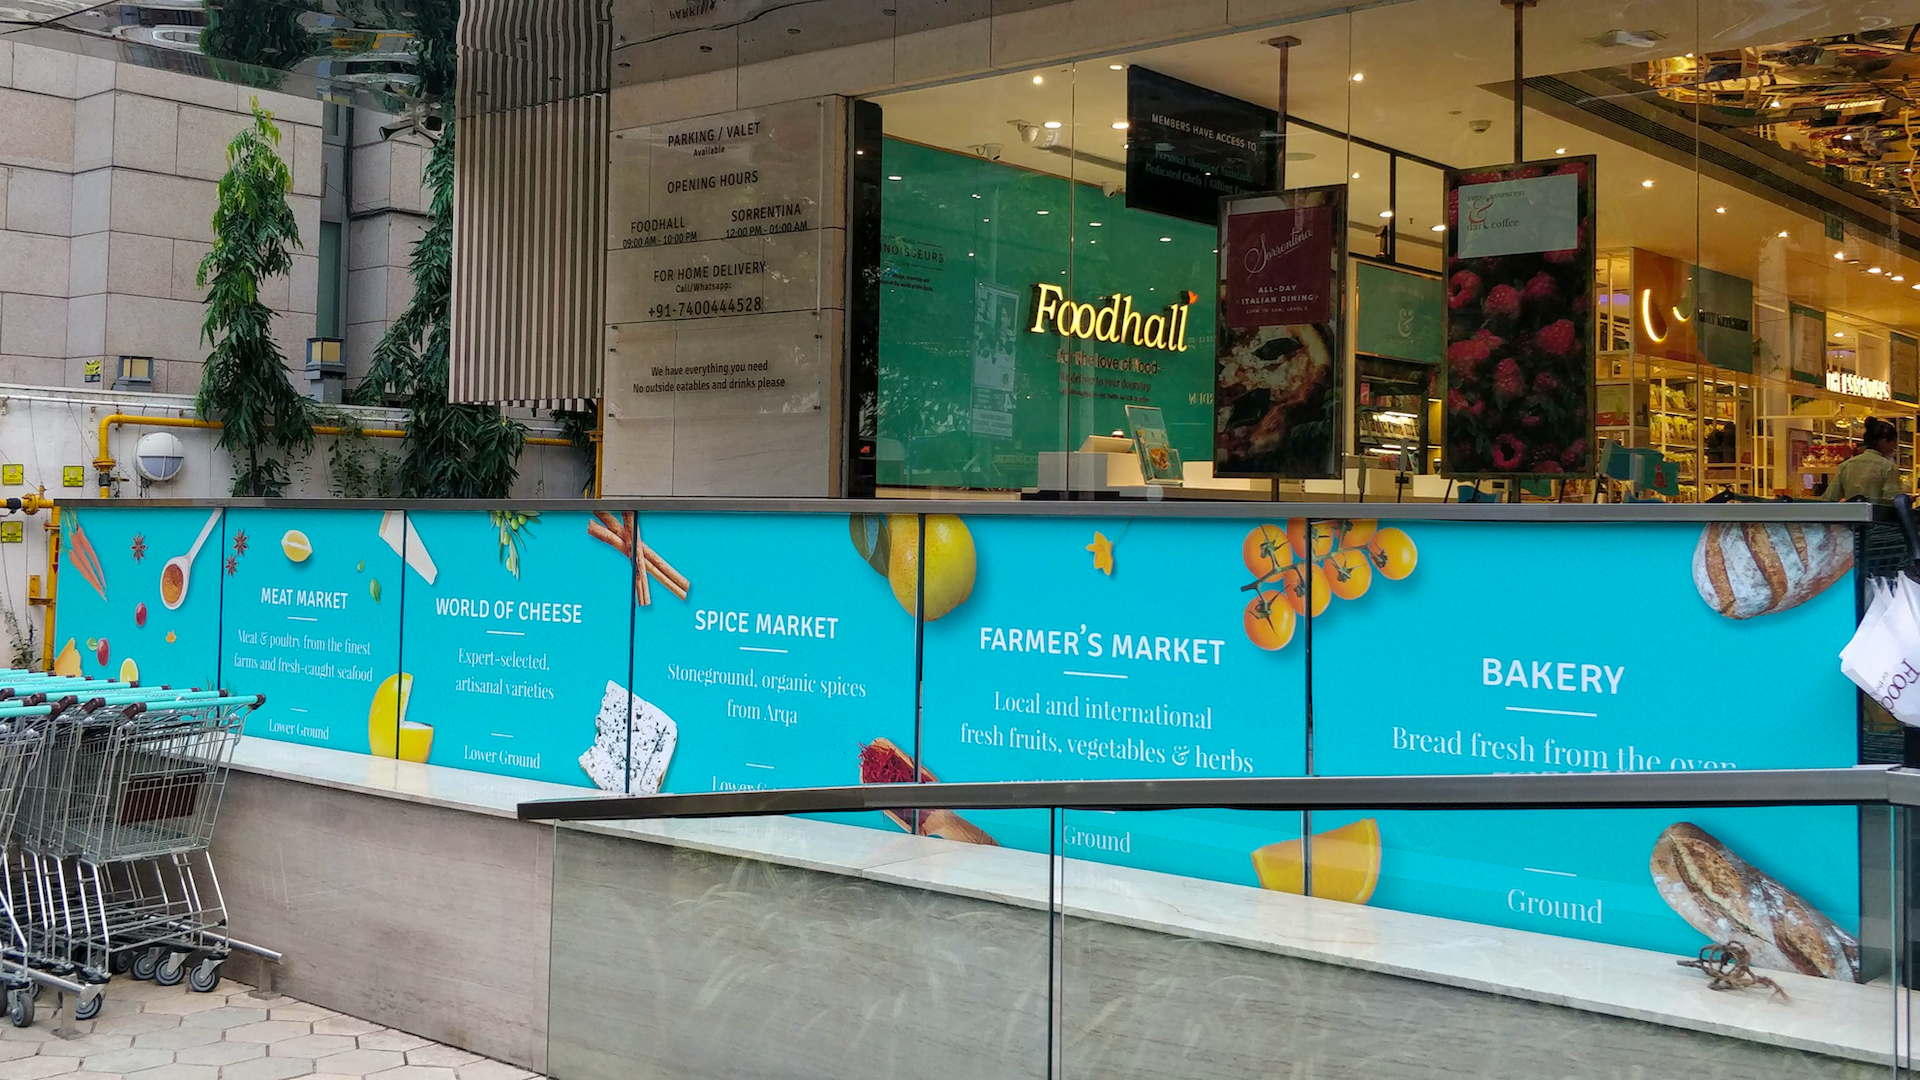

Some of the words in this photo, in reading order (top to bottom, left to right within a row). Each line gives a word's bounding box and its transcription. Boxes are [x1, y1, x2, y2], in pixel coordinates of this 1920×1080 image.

[667, 127, 715, 147] PARKING
[726, 121, 761, 138] VALET
[1152, 113, 1191, 133] MEMBERS
[1193, 125, 1214, 139] HAVE
[1216, 132, 1245, 149] ACCESS
[1247, 141, 1258, 152] TO
[693, 145, 725, 157] Available
[1155, 150, 1186, 166] Personal
[667, 176, 716, 194] OPENING
[719, 170, 759, 187] HOURS
[1145, 161, 1181, 180] Dedicated
[1182, 172, 1201, 186] Chefs
[731, 203, 802, 222] SORRENTINA
[630, 216, 685, 234] FOODHALL
[725, 228, 747, 239] 12:00
[749, 226, 762, 237] PM
[769, 223, 790, 234] 01:00
[791, 221, 808, 232] AM
[1467, 219, 1489, 232] dark
[1491, 218, 1520, 229] coffee
[622, 237, 643, 249] 09:00
[644, 235, 657, 247] AM
[663, 233, 684, 245] 10:00
[685, 232, 697, 243] PM
[1244, 227, 1314, 279] Sorrentina
[653, 269, 674, 282] FOR
[677, 265, 709, 280] HOME
[712, 261, 766, 277] DELIVERY
[675, 282, 732, 294] Call/Whatsapp:
[1241, 296, 1277, 306] ITALIAN
[1280, 293, 1314, 303] DINING
[1258, 284, 1297, 294] ALL-DAY
[648, 296, 762, 318] +91-7400444528
[1031, 283, 1189, 352] Foodhall
[651, 366, 663, 378] We
[665, 364, 683, 376] have
[685, 361, 729, 377] everything
[730, 364, 745, 375] you
[747, 359, 768, 372] need
[1096, 353, 1119, 369] love
[1121, 357, 1133, 371] of
[633, 382, 645, 394] No
[646, 380, 675, 393] outside
[676, 378, 710, 391] eatables
[711, 377, 727, 389] and
[728, 376, 755, 389] drinks
[757, 376, 785, 390] please
[1095, 376, 1104, 385] to
[1105, 378, 1120, 389] your
[1121, 379, 1151, 392] doorstep
[261, 587, 292, 606] MEAT
[296, 590, 349, 610] MARKET
[436, 597, 490, 618] WORLD
[493, 600, 514, 620] OF
[518, 602, 583, 624] CHEESE
[694, 609, 749, 633] SPICE
[755, 613, 839, 639] MARKET
[237, 629, 258, 645] Meat
[259, 631, 267, 646] &
[269, 633, 301, 651] poultry
[302, 634, 326, 651] from
[327, 636, 343, 653] the
[344, 639, 371, 656] finest
[1112, 634, 1226, 665] MARKET
[233, 654, 258, 670] farms
[259, 657, 276, 671] and
[277, 657, 335, 679] fresh-caught
[337, 664, 373, 682] seafood
[458, 648, 550, 672] Expert-selected,
[667, 663, 758, 688] Stoneground,
[762, 673, 816, 694] organic
[820, 676, 866, 698] spices
[1482, 657, 1625, 695] BAKERY
[455, 677, 503, 695] artisanal
[505, 680, 555, 701] varieties
[727, 699, 760, 720] from
[764, 703, 798, 727] Arqa
[994, 691, 1041, 714] Local
[1046, 696, 1079, 718] and
[1085, 698, 1212, 730] international
[269, 718, 294, 735] Lower
[296, 721, 329, 741] Ground
[464, 745, 497, 765] Lower
[499, 749, 541, 769] Ground
[960, 722, 1004, 746] fresh
[1009, 726, 1062, 754] fruits,
[1067, 737, 1166, 764] vegetables
[1171, 744, 1191, 766] &
[1195, 745, 1254, 774] herbs
[1392, 725, 1462, 756] Bread
[1470, 732, 1535, 763] fresh
[1543, 738, 1609, 770] from
[1617, 745, 1661, 771] the
[1063, 824, 1131, 853] Ground
[1507, 888, 1603, 924] Ground
